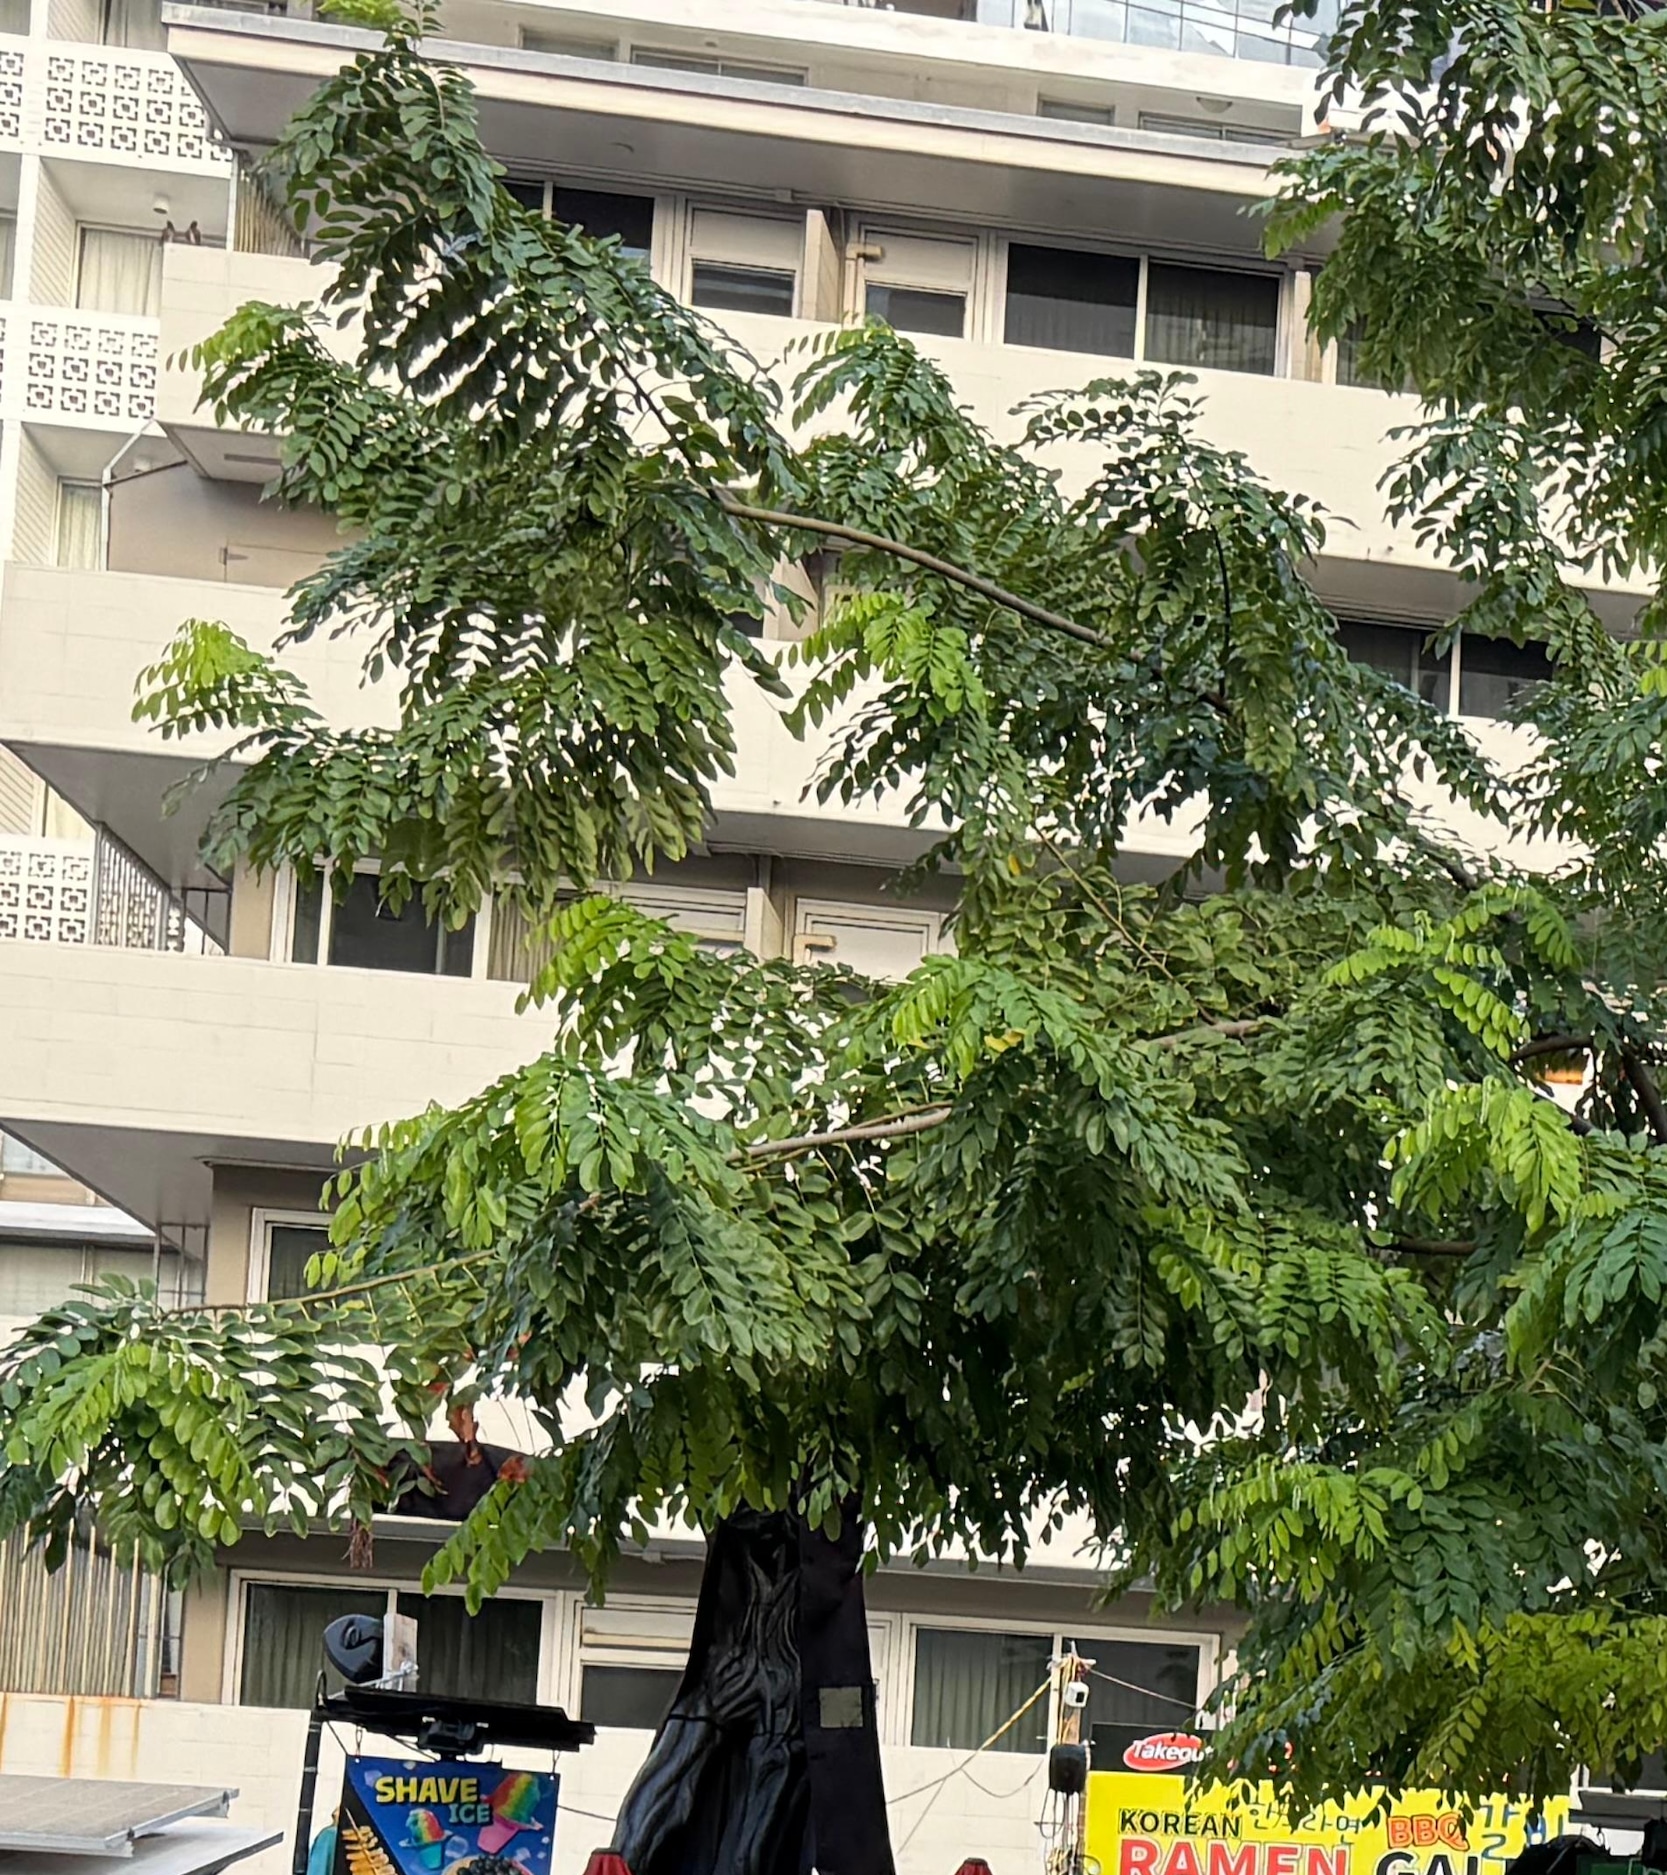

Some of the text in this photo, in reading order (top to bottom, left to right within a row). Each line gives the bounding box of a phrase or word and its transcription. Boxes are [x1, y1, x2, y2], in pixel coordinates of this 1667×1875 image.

[374, 1776, 479, 1804] SHAVE
[449, 1803, 491, 1825] ICE
[1119, 1808, 1242, 1838] KOREAN
[1388, 1813, 1469, 1850] BBQ
